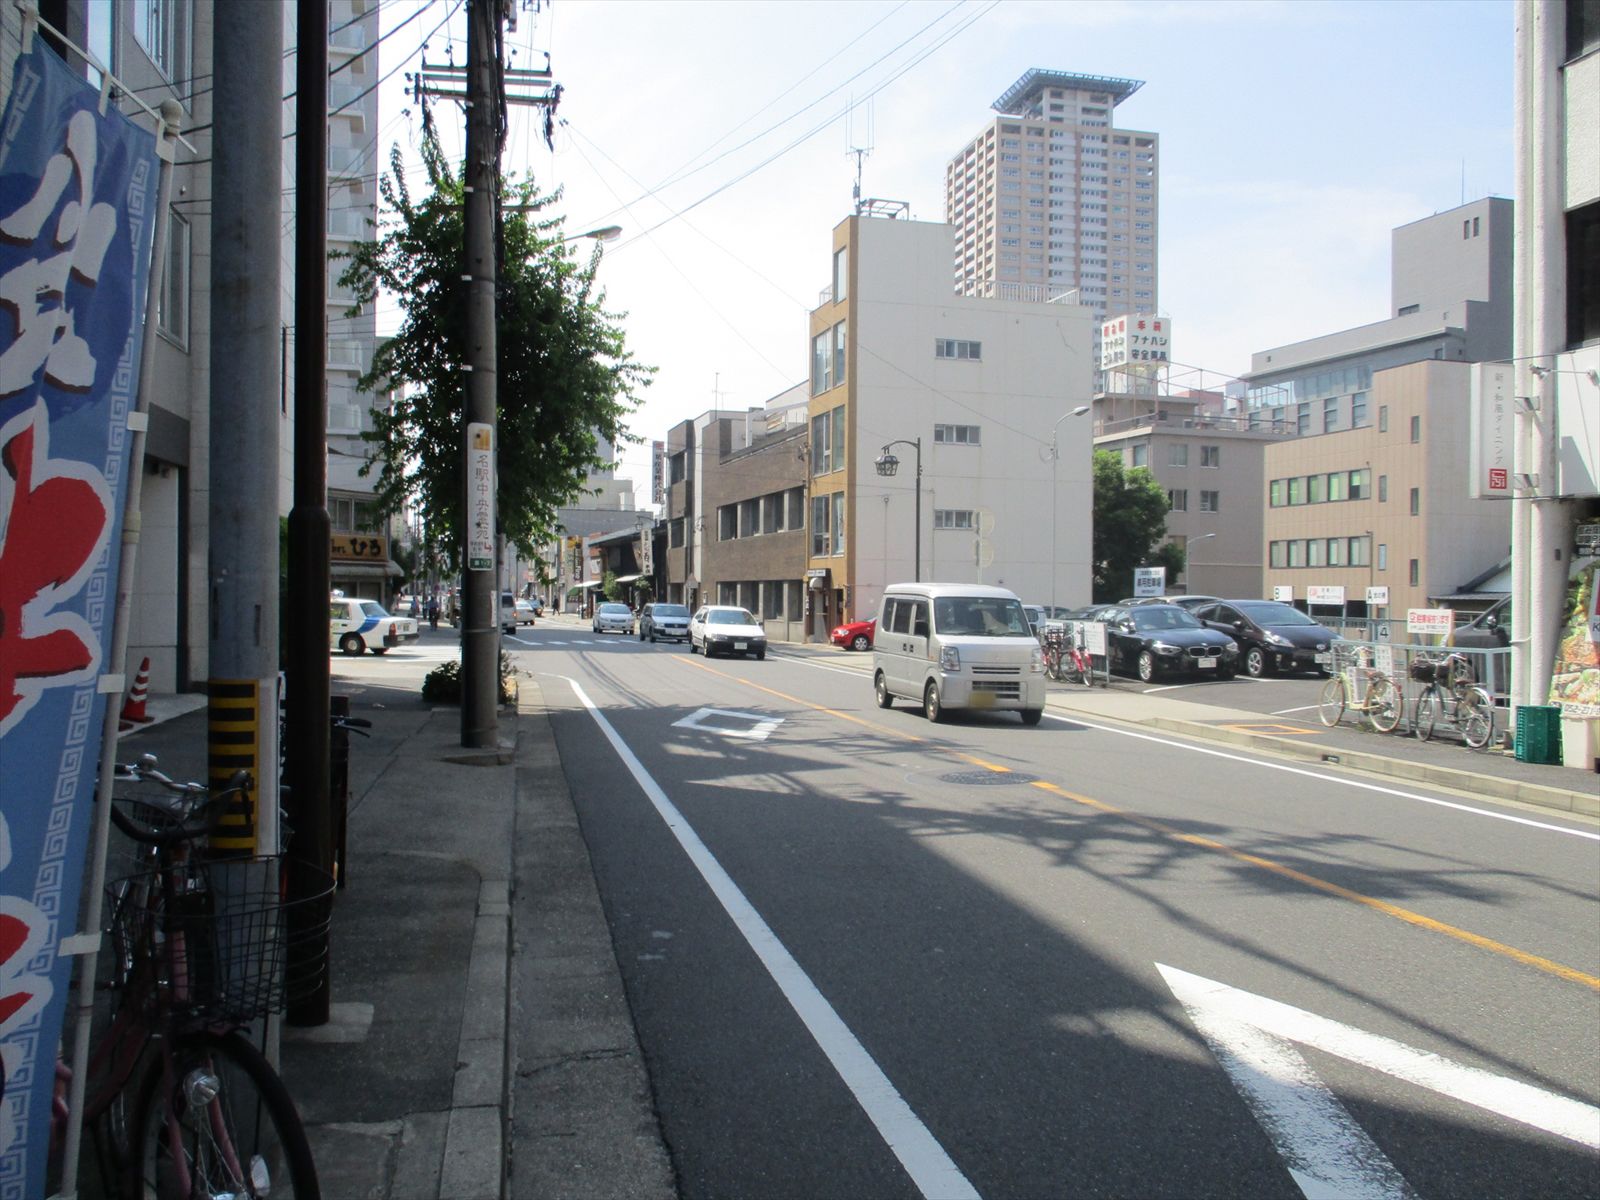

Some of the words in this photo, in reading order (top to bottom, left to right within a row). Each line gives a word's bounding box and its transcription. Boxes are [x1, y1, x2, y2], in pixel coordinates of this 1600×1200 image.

[1131, 335, 1167, 346] フナハシ
[1367, 589, 1373, 602] A
[1380, 627, 1388, 638] 4
